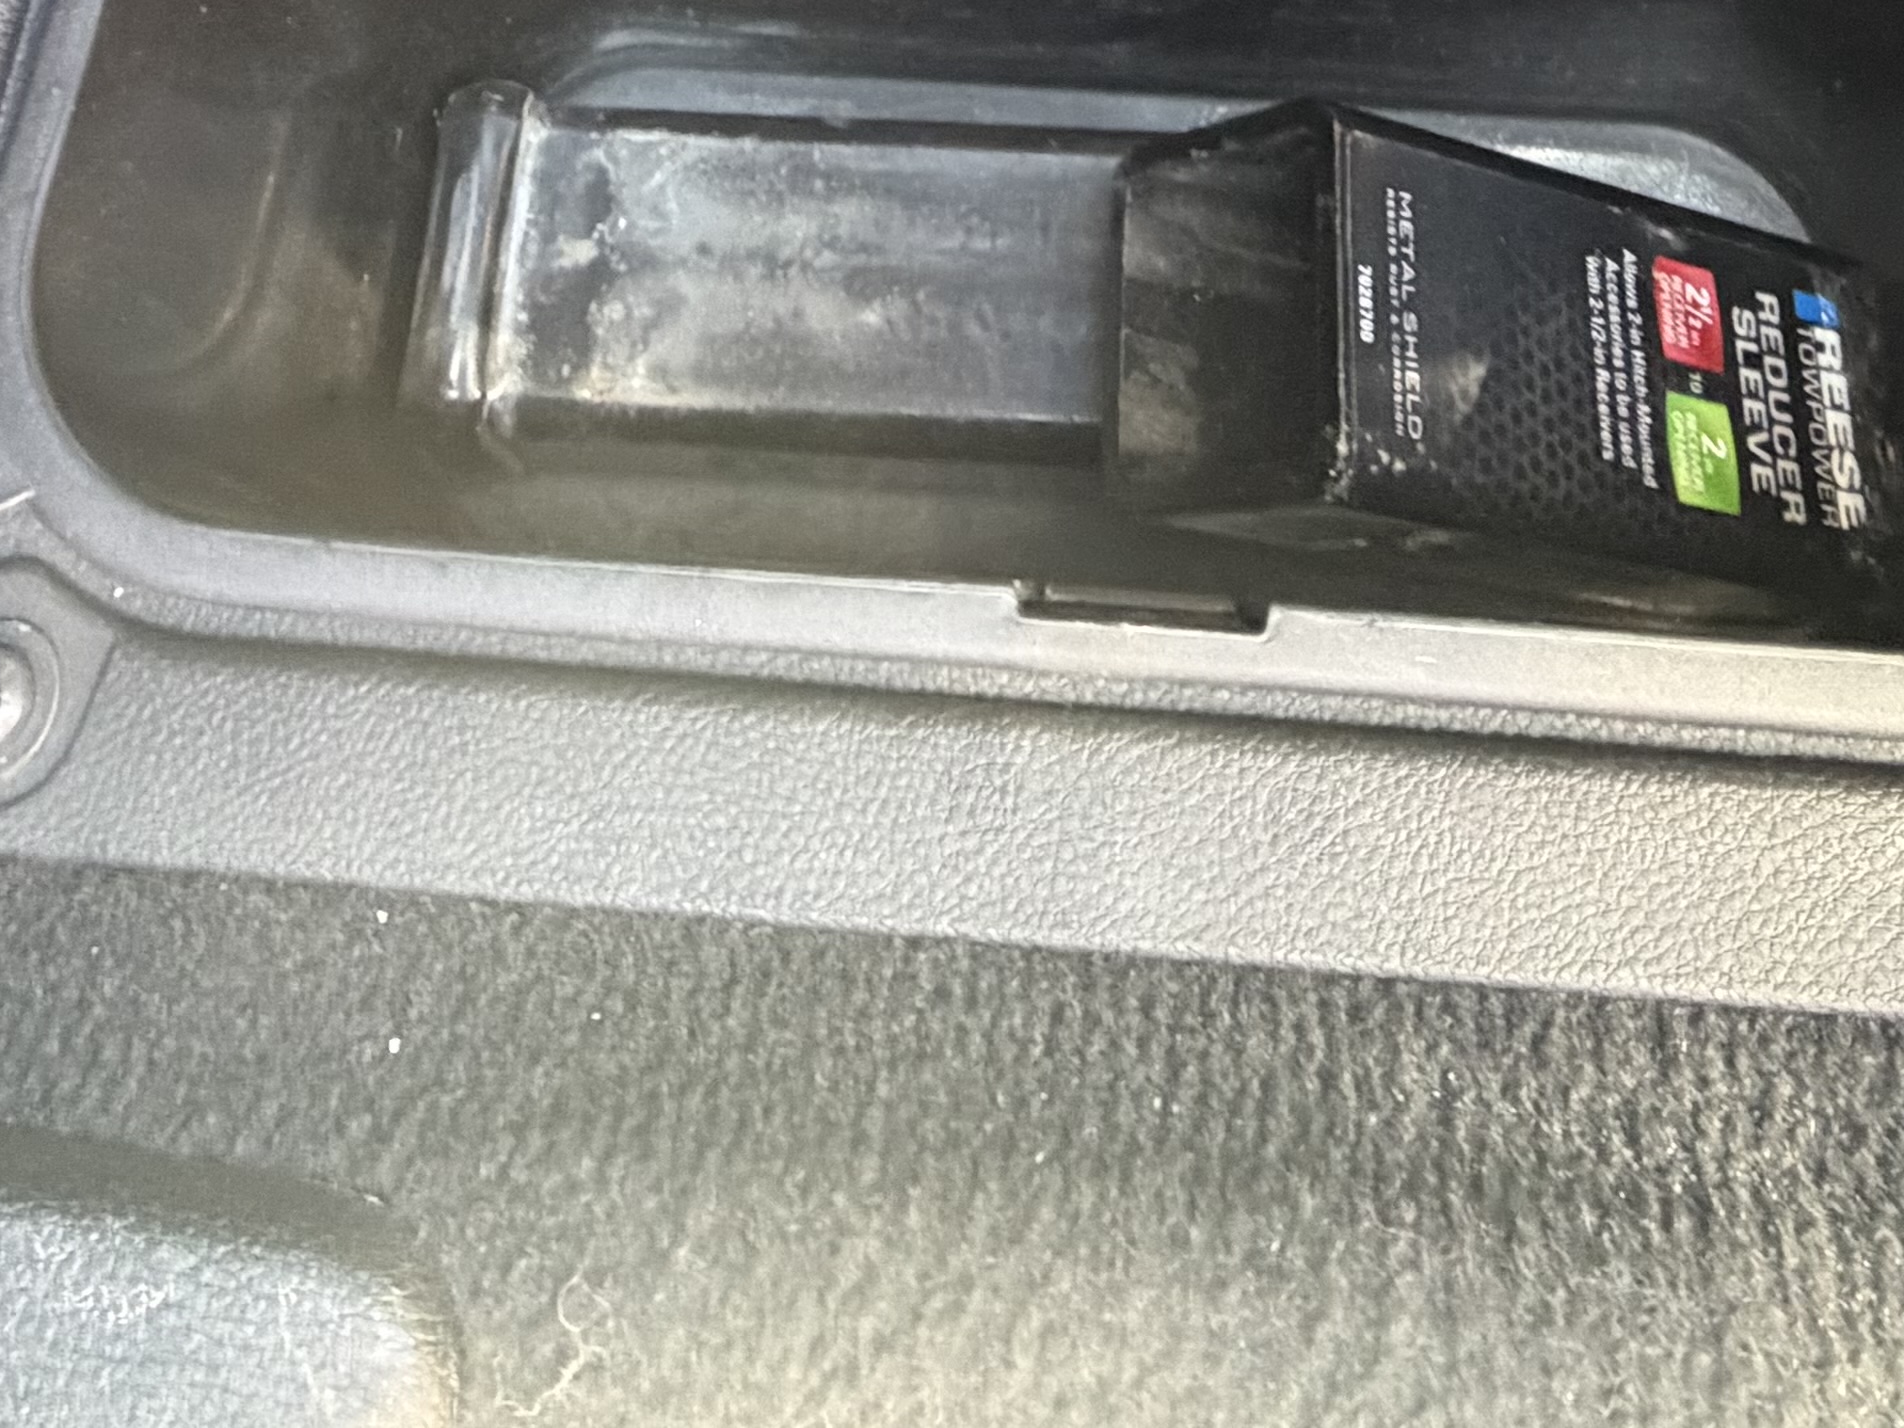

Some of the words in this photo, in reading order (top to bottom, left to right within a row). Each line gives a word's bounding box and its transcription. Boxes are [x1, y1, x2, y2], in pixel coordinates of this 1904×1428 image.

[1399, 190, 1416, 302] METAL
[1623, 247, 1639, 310] Allows
[1588, 296, 1608, 366] 2-1/2-in
[1605, 257, 1625, 369] Accessories
[1627, 311, 1645, 347] 2-in
[1402, 311, 1424, 440] SHIELD
[1596, 367, 1615, 462] Receivers
[1614, 371, 1628, 392] to
[1616, 394, 1632, 419] be
[1631, 349, 1659, 490] Hitch-Mounted
[1732, 305, 1778, 498] SLEEVE
[1754, 291, 1807, 526] REDUCER
[1618, 422, 1638, 470] used
[1700, 432, 1727, 460] 2
[1797, 327, 1841, 528] TOWPOWER
[1814, 327, 1866, 531] REESE
